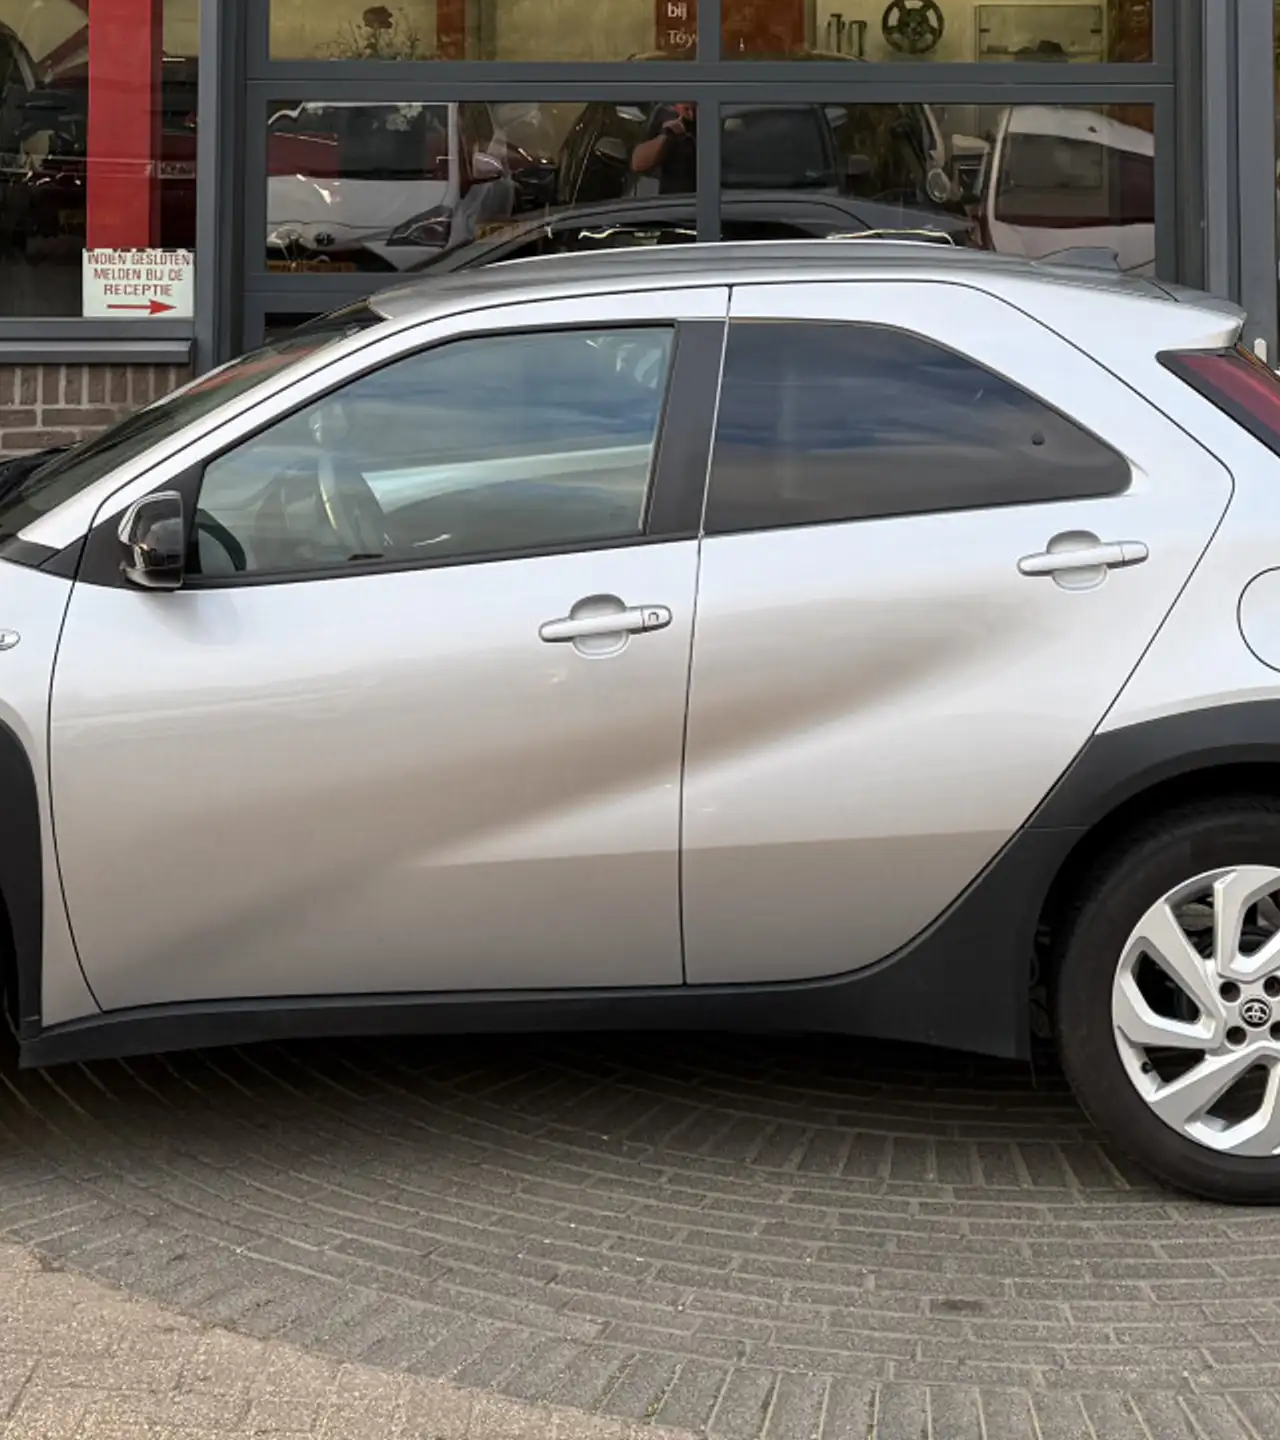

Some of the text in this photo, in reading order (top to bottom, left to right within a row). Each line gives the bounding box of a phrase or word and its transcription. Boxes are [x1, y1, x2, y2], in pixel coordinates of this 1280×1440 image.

[667, 1, 688, 21] bij
[88, 251, 191, 266] INDIEN GESLOTEN
[93, 267, 183, 281] MELDEN BIJ DE
[103, 283, 173, 297] RECEPTIE
